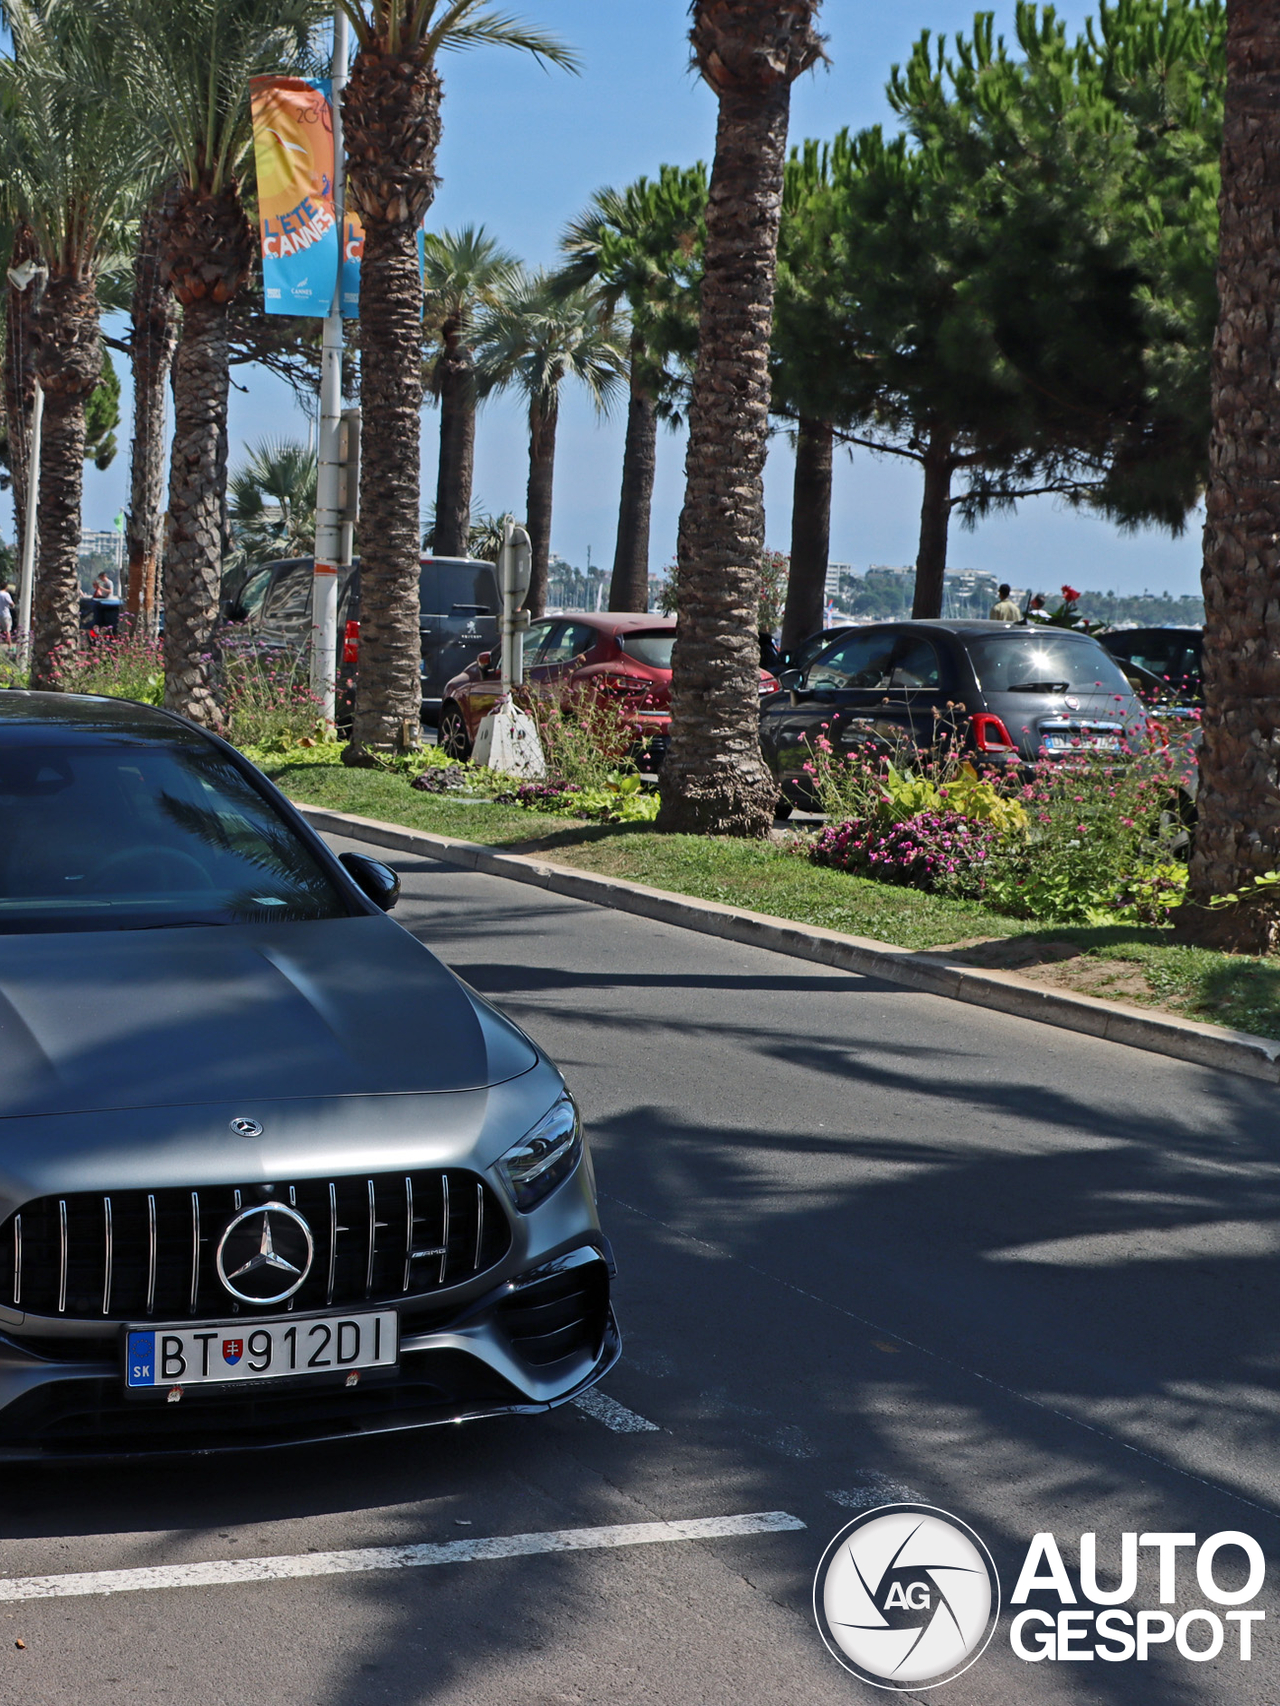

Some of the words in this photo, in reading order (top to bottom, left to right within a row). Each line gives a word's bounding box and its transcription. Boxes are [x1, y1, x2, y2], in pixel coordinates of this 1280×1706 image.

[263, 206, 335, 259] CANNES
[291, 288, 312, 296] CANNES
[133, 1365, 150, 1377] SK
